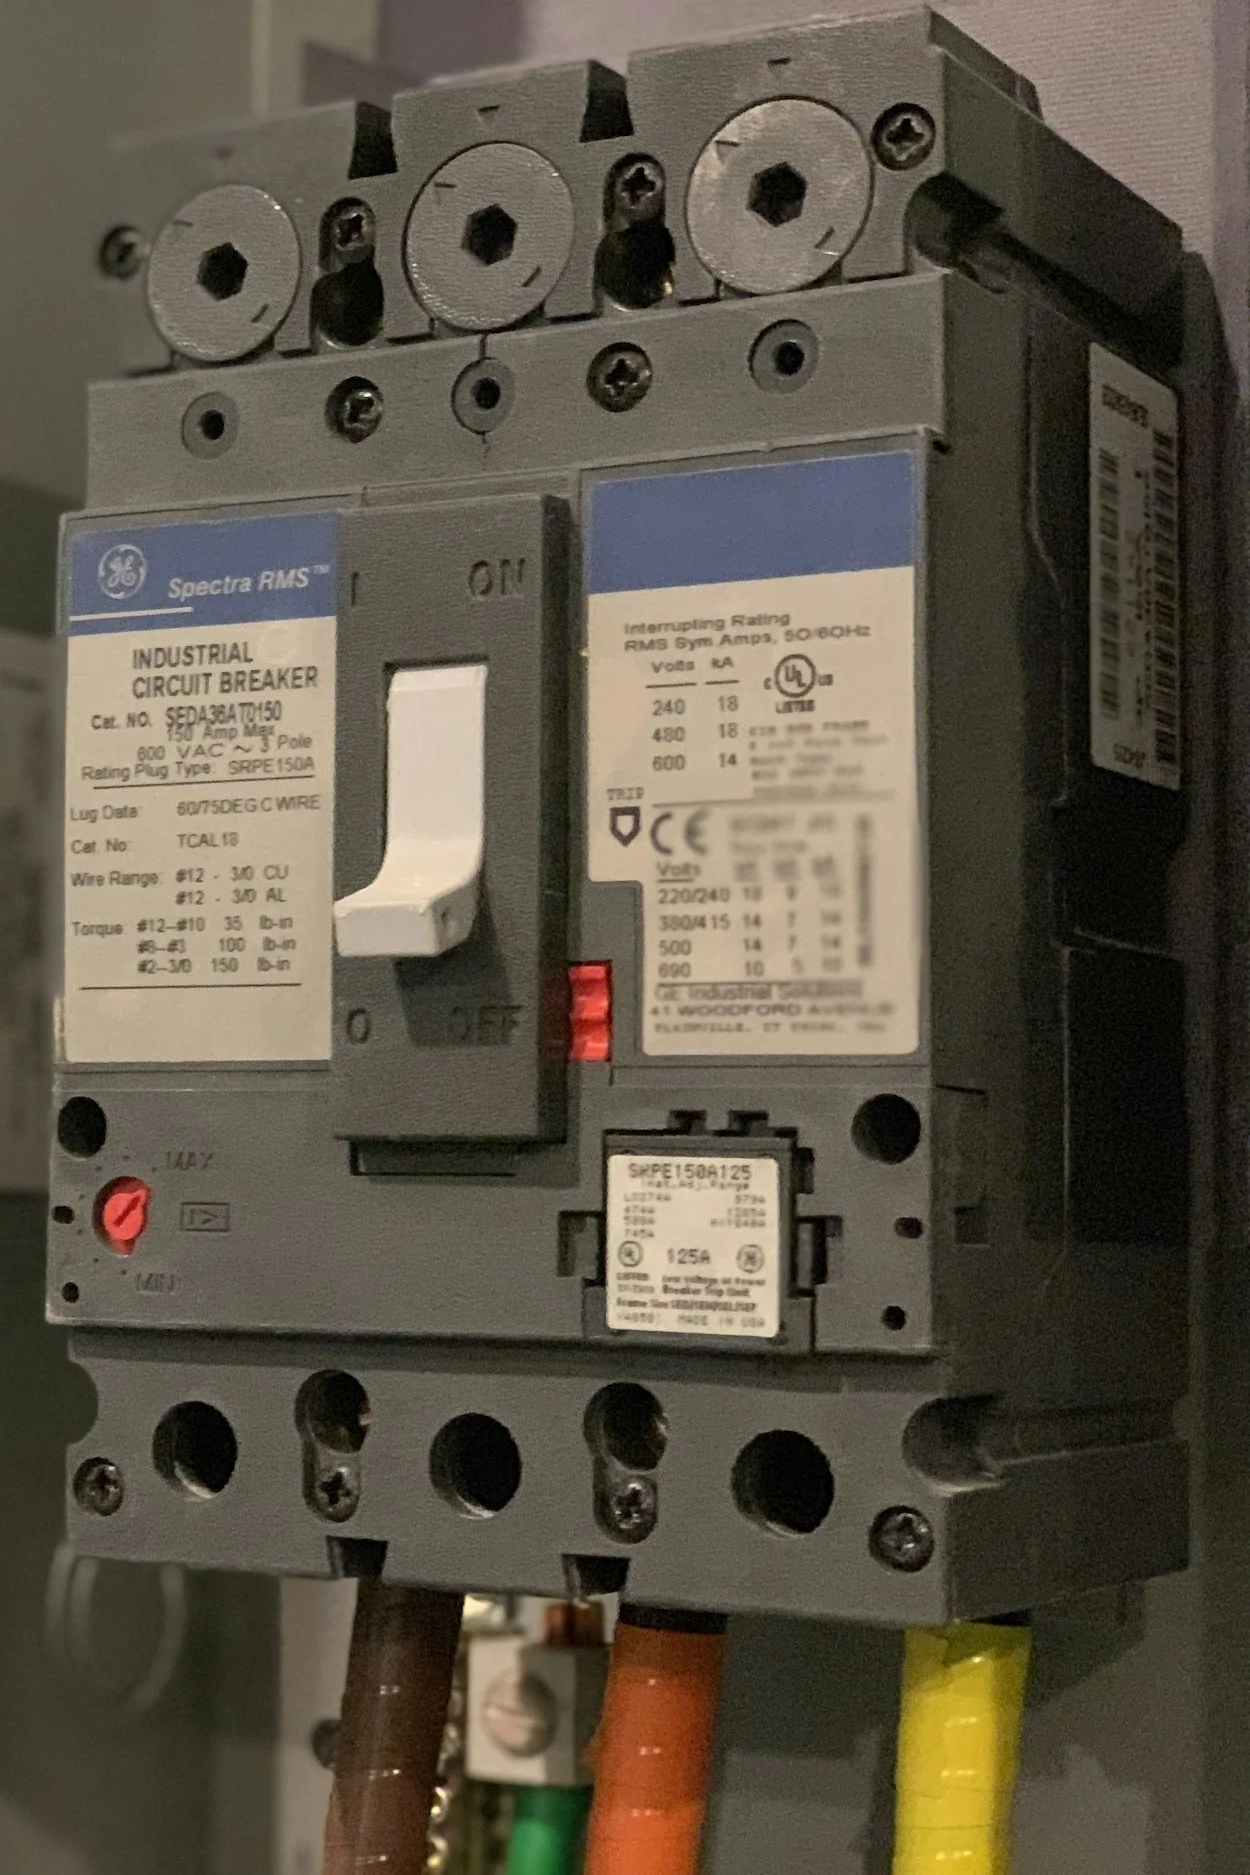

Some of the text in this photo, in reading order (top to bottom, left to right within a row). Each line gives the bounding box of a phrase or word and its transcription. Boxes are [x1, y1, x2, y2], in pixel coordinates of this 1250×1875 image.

[468, 558, 527, 597] ON
[168, 575, 251, 602] Spectra
[624, 613, 791, 636] Interrupting Rating
[624, 637, 669, 653] RMS
[674, 634, 713, 652] Sym
[132, 641, 253, 669] INDUSTRIAL
[651, 659, 695, 674] Volts
[132, 665, 318, 698] CIRCUIT BREAKER
[652, 695, 739, 717] 240 18
[167, 722, 275, 742] 150 Amp Max
[652, 726, 686, 743] 480
[718, 722, 739, 739] 18
[137, 746, 165, 761] 600
[177, 743, 223, 759] VAC
[277, 734, 312, 750] Pole
[81, 763, 131, 782] Rating
[135, 761, 168, 780] Plug
[228, 756, 316, 776] SRPE150A
[652, 754, 687, 771] 600
[718, 752, 738, 769] 14
[276, 794, 322, 812] WIRE
[70, 806, 98, 823] Lug
[70, 871, 105, 887] Wire
[175, 867, 205, 883] #12
[263, 864, 289, 880] CU
[175, 891, 205, 905] #12
[265, 887, 287, 902] AL
[223, 915, 243, 931] 35
[218, 937, 246, 952] 100
[658, 940, 692, 957] 500
[211, 957, 239, 973] 150
[678, 1003, 800, 1017] WOODFORD
[453, 1005, 521, 1042] OFF
[667, 1248, 711, 1264] 125A
